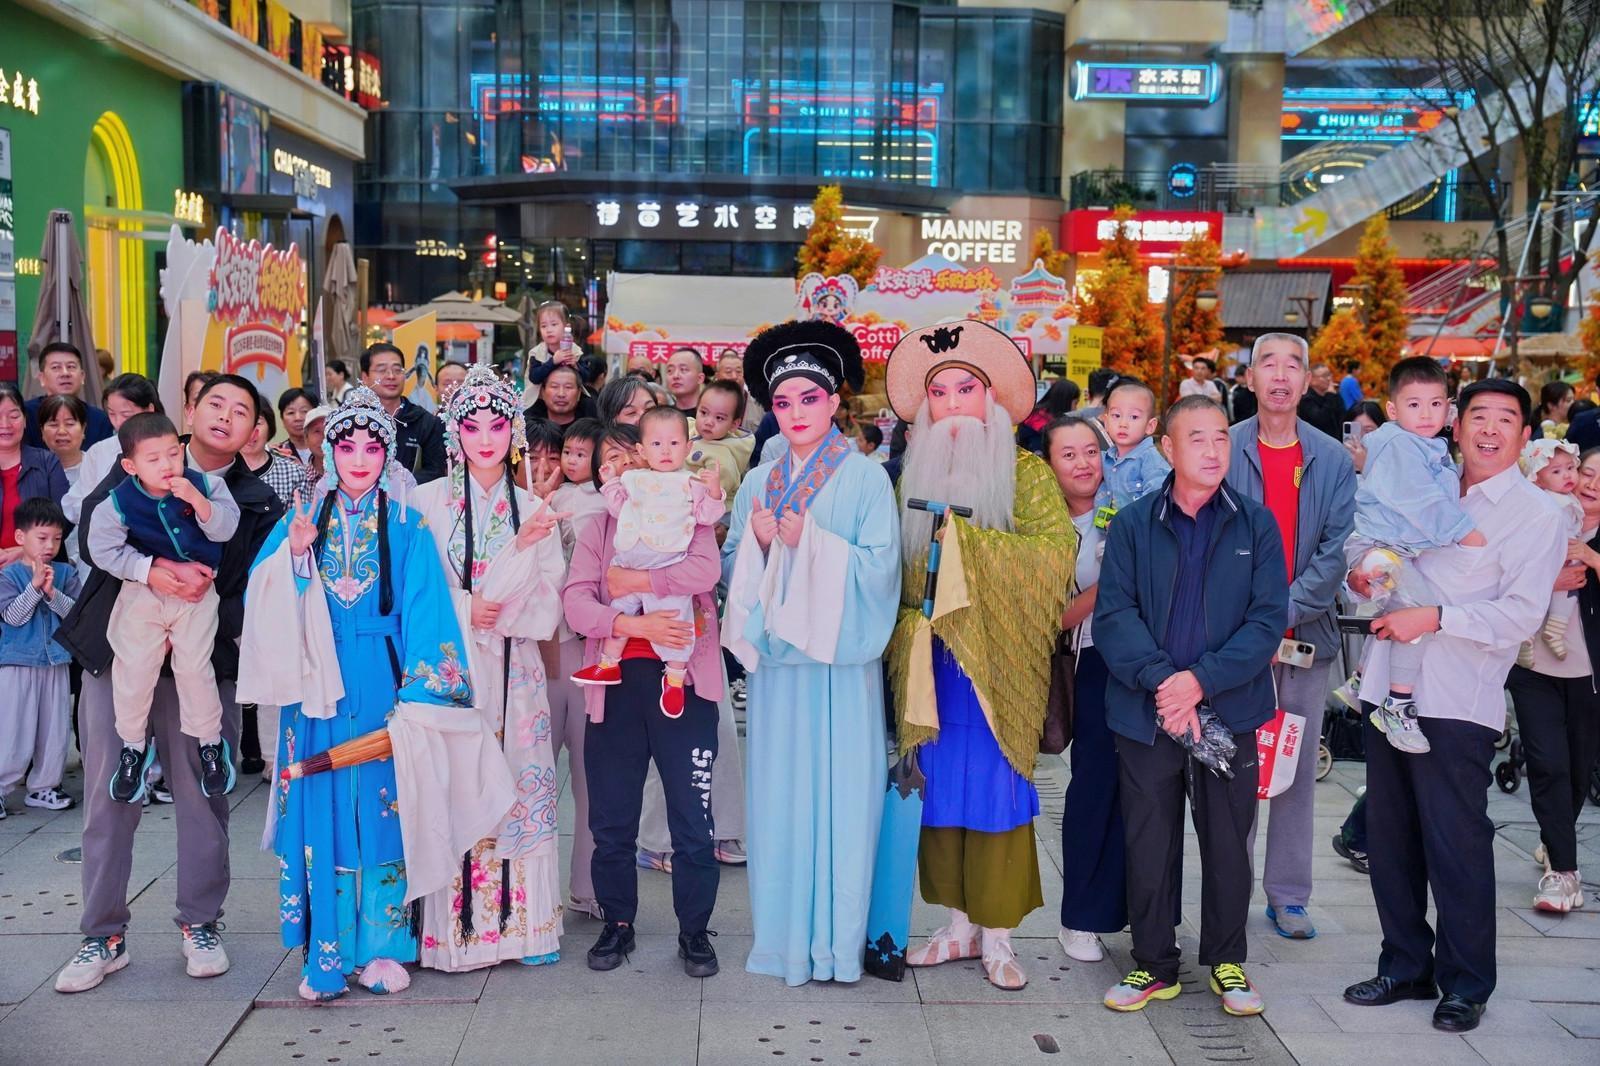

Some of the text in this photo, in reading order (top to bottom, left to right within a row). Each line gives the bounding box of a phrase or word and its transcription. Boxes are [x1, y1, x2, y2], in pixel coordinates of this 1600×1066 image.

[1318, 114, 1355, 126] SHUI
[921, 219, 1022, 240] MANNER
[927, 241, 1017, 263] COFFEE
[855, 329, 897, 343] Cotti
[860, 345, 891, 360] offe
[1281, 723, 1299, 758] 乡村基
